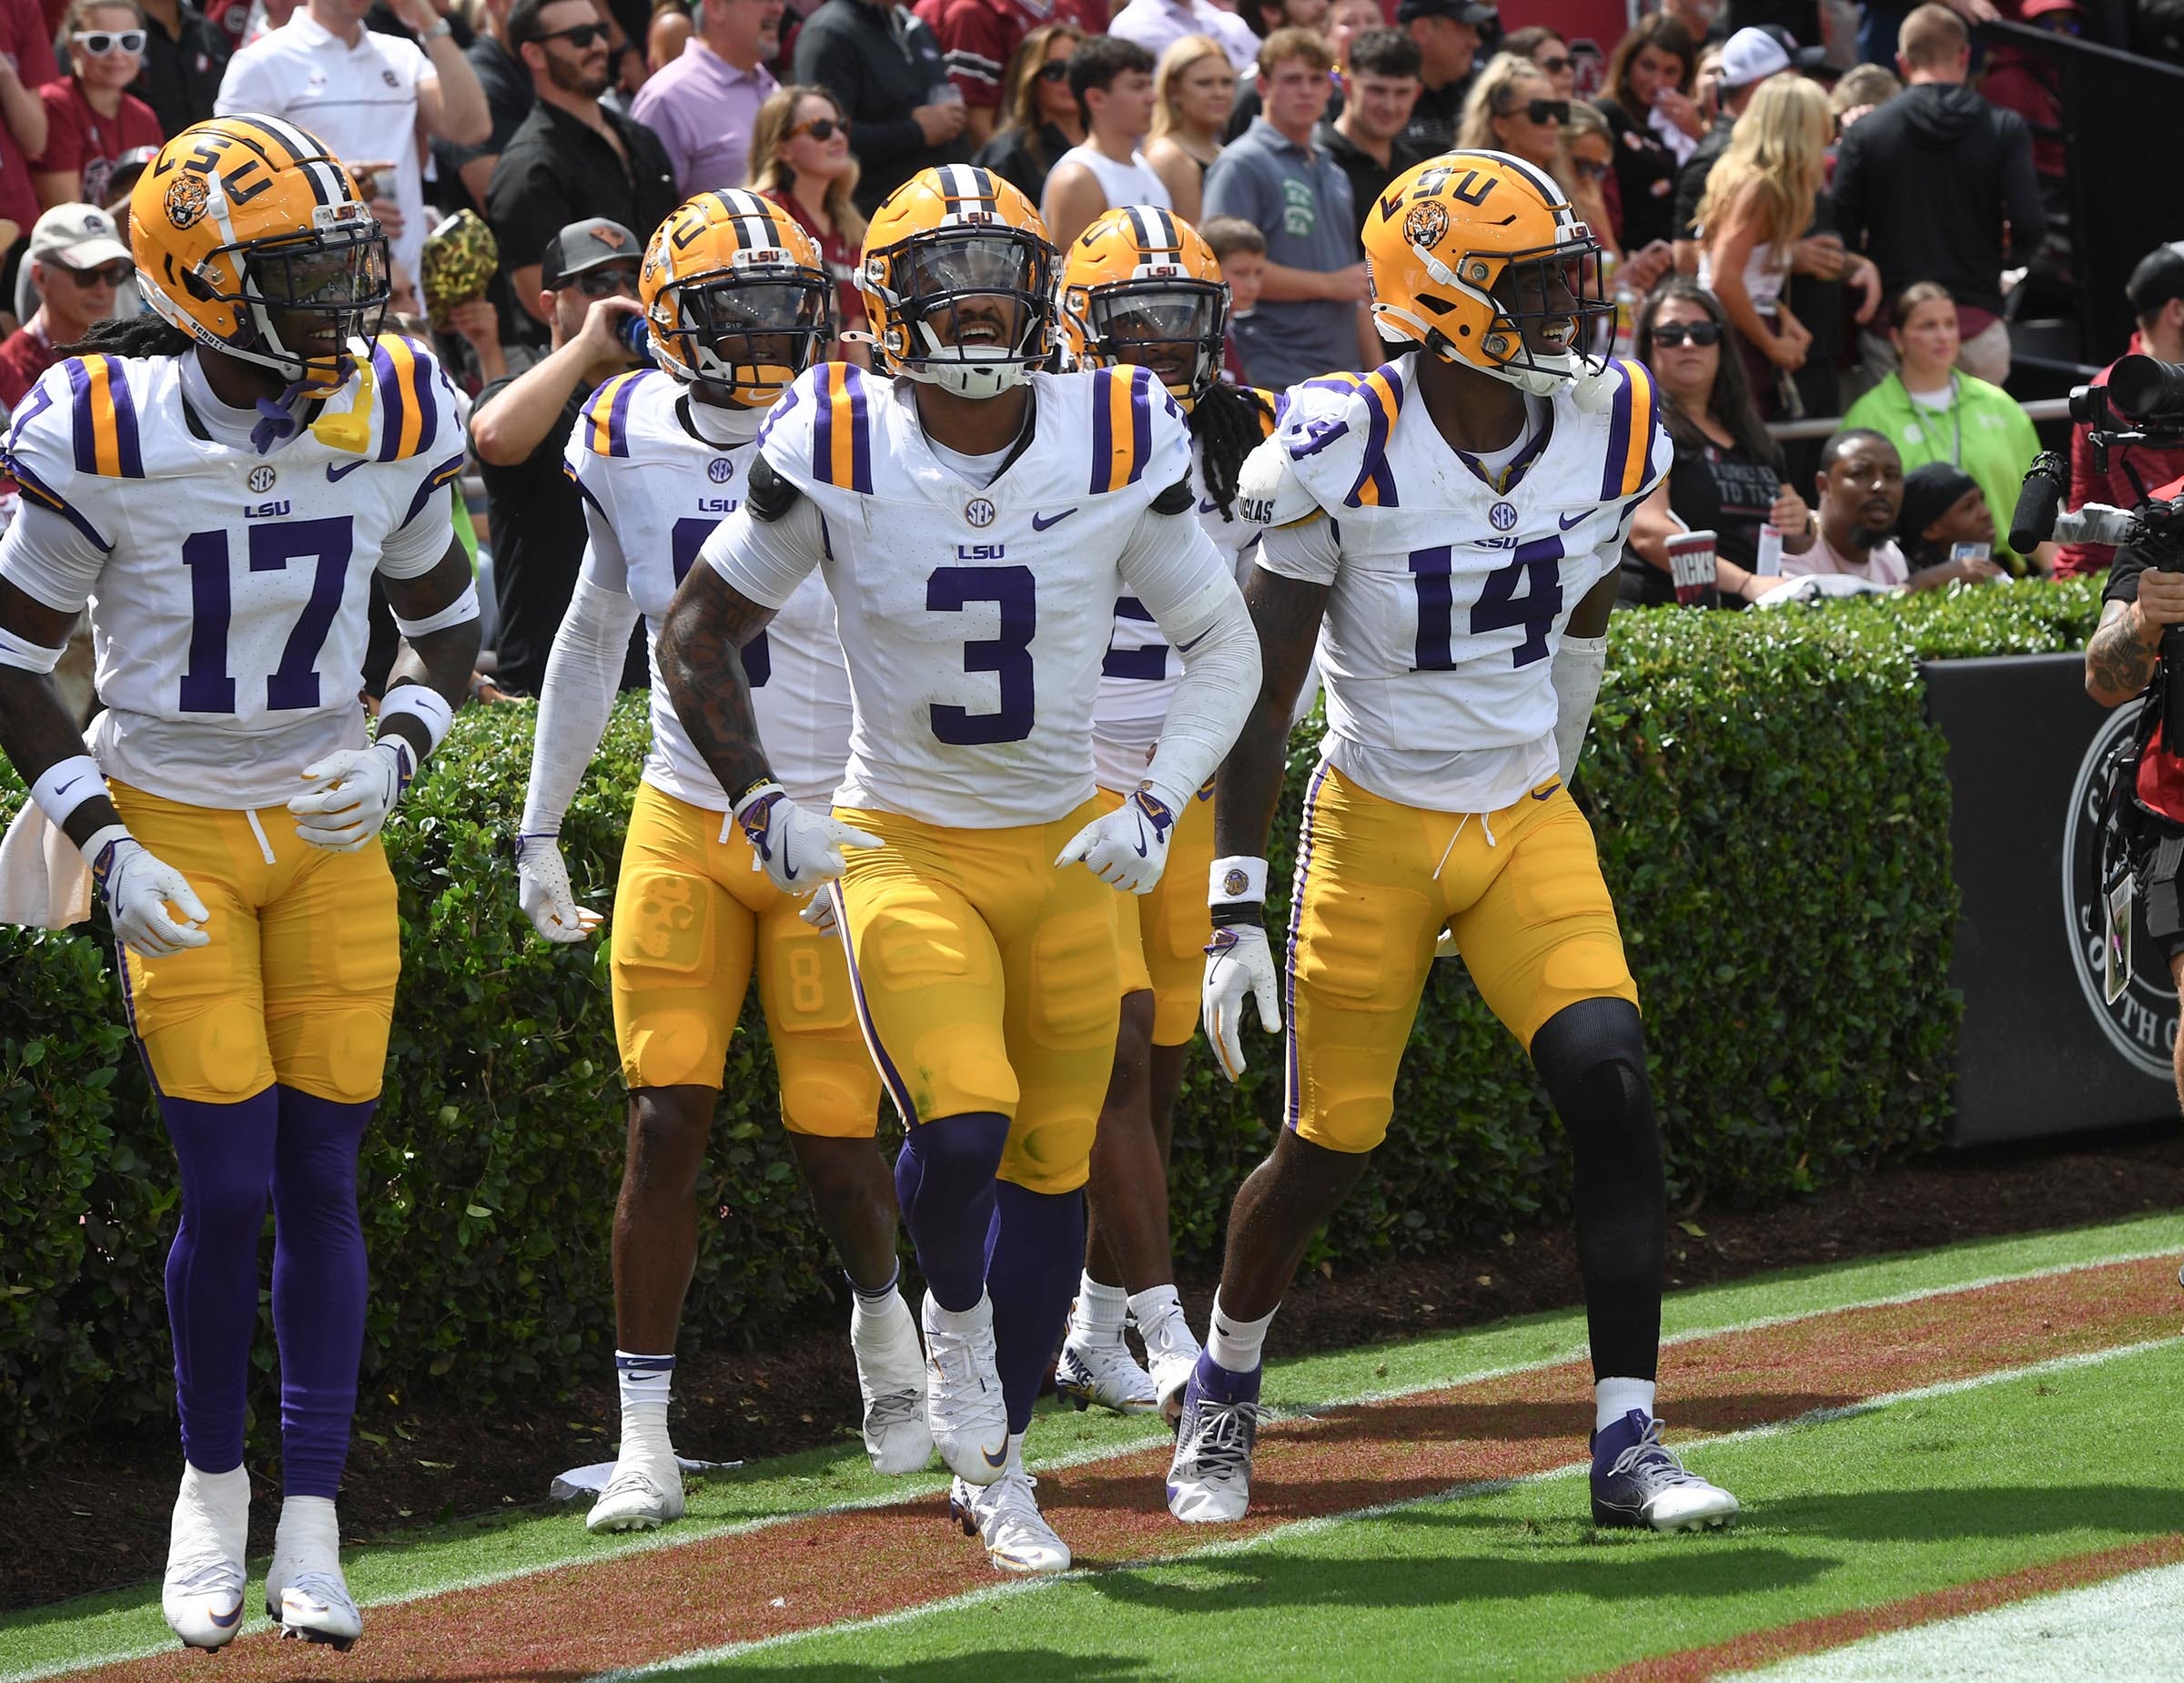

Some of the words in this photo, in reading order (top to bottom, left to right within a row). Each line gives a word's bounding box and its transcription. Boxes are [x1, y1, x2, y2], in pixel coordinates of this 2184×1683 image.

[153, 139, 273, 206] LSU
[1380, 167, 1499, 223] LSU
[957, 211, 994, 225] LSU
[747, 250, 780, 264] LSU
[1147, 266, 1178, 278] LSU
[250, 464, 276, 492] SEC
[710, 459, 733, 483] SEC
[244, 500, 290, 518] LSU
[698, 498, 737, 512] LSU
[967, 500, 995, 526] SEC
[1491, 505, 1517, 532] SEC
[958, 544, 1005, 560] LSU
[179, 515, 354, 714] 17
[1409, 534, 1565, 673] 14
[925, 565, 1036, 745] 3
[1064, 1346, 1094, 1388] NIKE
